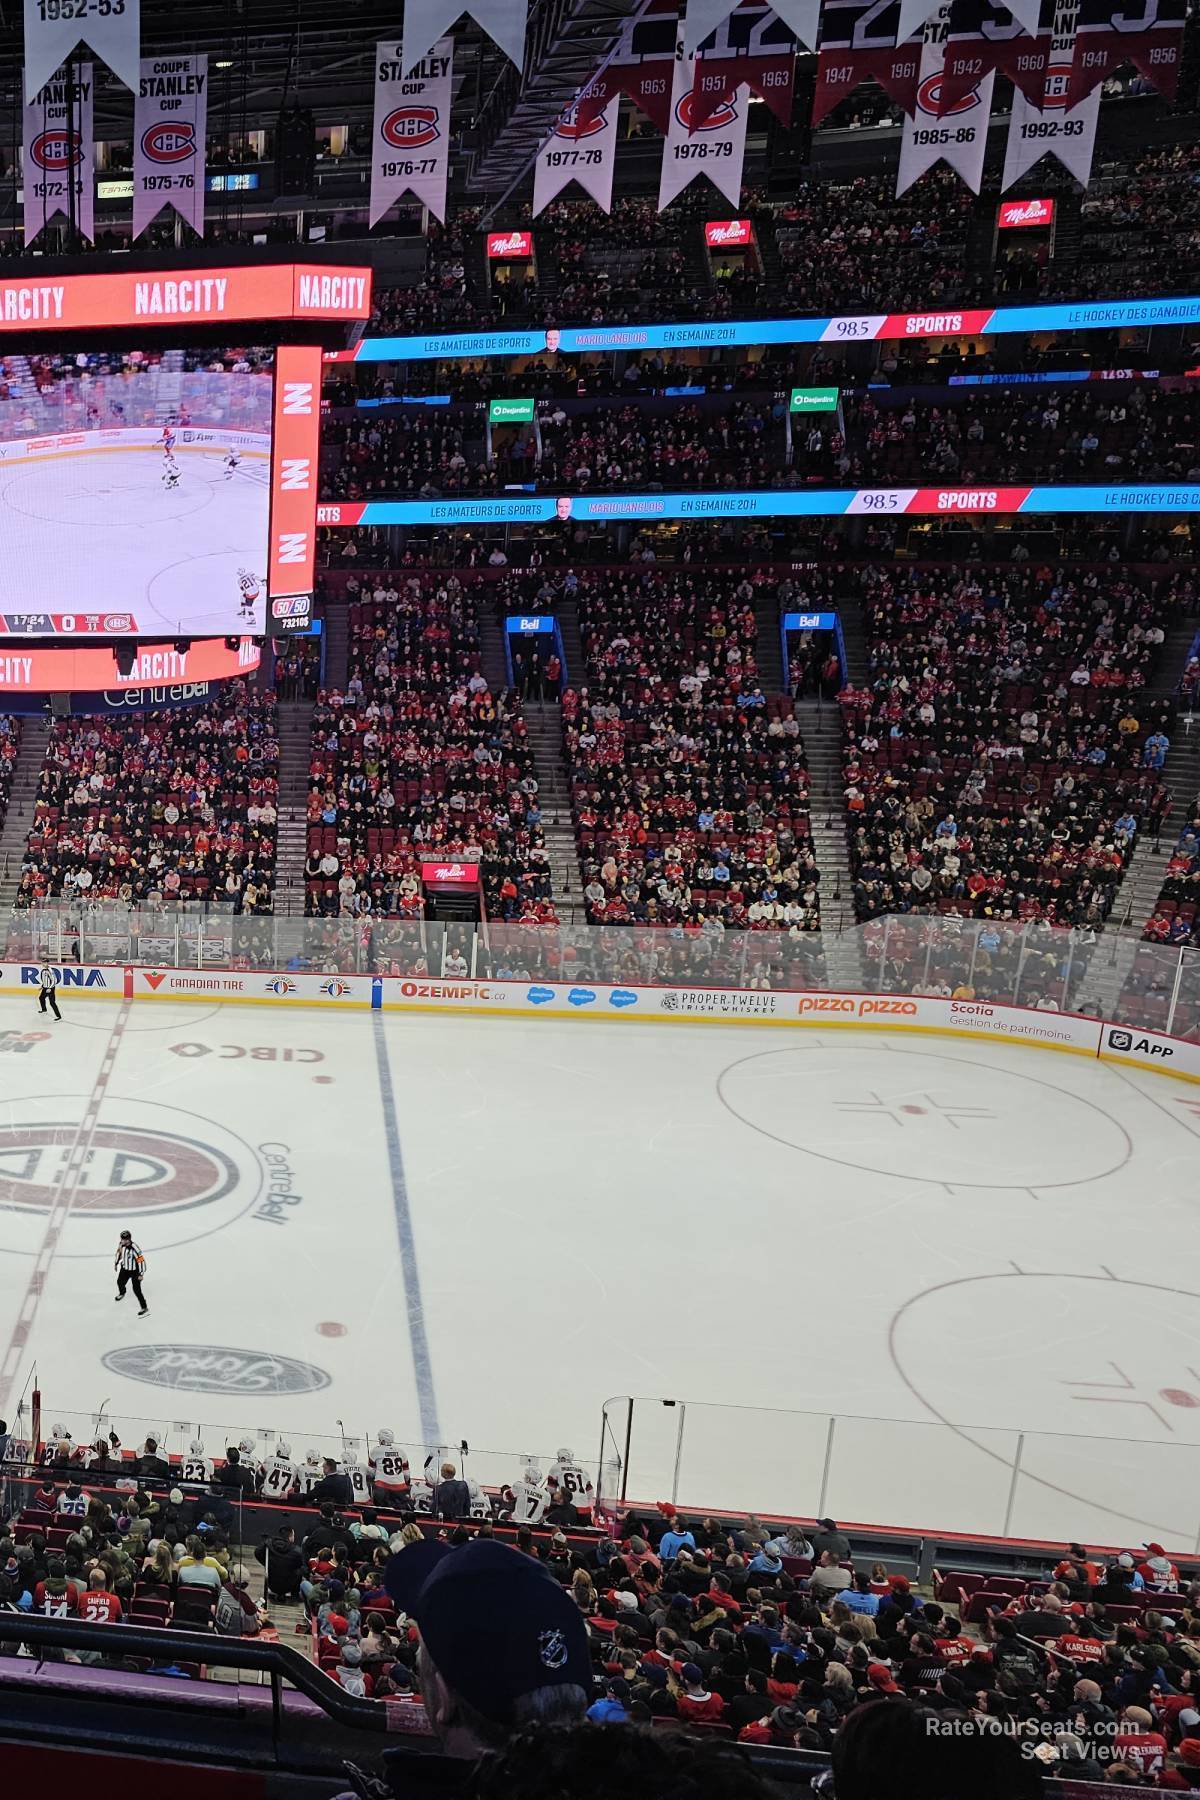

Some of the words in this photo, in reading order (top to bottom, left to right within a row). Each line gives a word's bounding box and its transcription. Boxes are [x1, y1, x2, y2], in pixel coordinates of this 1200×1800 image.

[1016, 54, 1045, 72] 1960
[1081, 50, 1108, 68] 1941
[1149, 48, 1177, 65] 1956
[153, 61, 190, 74] COUPE
[825, 66, 853, 84] 1947
[890, 62, 916, 79] 1961
[952, 58, 983, 76] 1942
[140, 75, 205, 98] STANLEY
[640, 79, 667, 95] 1963
[701, 75, 727, 93] 1951
[762, 71, 790, 88] 1963
[402, 83, 426, 95] CUP
[160, 99, 182, 111] CUP
[912, 128, 976, 145] 1985-86
[1019, 120, 1085, 139] 1992-93
[546, 150, 603, 167] 1977-78
[674, 142, 734, 160] 1978-79
[381, 159, 437, 177] 1976-77
[142, 175, 195, 190] 1975-76
[135, 278, 227, 315] NARCITY
[299, 274, 366, 309] NARCITY
[1083, 309, 1125, 322] HOCKEY
[1127, 308, 1147, 320] DES
[836, 321, 869, 337] 98.5
[906, 314, 962, 334] SPORTS
[424, 341, 438, 352] LES
[440, 339, 482, 351] AMATEURS
[498, 336, 531, 349] SPORTS
[663, 330, 674, 342] EN
[676, 329, 716, 341] SEMAINE
[681, 501, 693, 512] EN
[694, 500, 735, 511] SEMAINE
[863, 494, 898, 510] 98.5
[937, 492, 997, 510] SPORTS
[1105, 493, 1117, 505] LE
[1121, 493, 1164, 505] HOCKEY
[1167, 492, 1189, 504] DES
[431, 507, 445, 518] LES
[447, 505, 491, 518] AMATEURS
[493, 506, 505, 516] DE
[508, 504, 542, 516] SPORTS
[276, 599, 308, 615] 50/50
[13, 615, 45, 625] 17:24
[62, 615, 76, 632] 0
[520, 619, 540, 630] Bell
[799, 615, 820, 627] Bell
[170, 978, 221, 990] CANADIAN
[222, 979, 244, 991] TIRE
[682, 992, 728, 1005] PROPER
[732, 994, 776, 1008] TWELVE
[798, 997, 855, 1016] pizza
[858, 998, 918, 1017] pizza
[681, 1004, 715, 1012] IRISH
[722, 1005, 776, 1014] WHISKEY
[950, 1002, 994, 1017] Scotia
[949, 1014, 992, 1031] Gestion
[993, 1020, 1008, 1032] de
[1009, 1021, 1071, 1042] patrimoine
[219, 1044, 326, 1063] CIBC
[250, 1141, 303, 1226] CentreBell
[149, 1351, 284, 1390] Ford
[185, 1464, 206, 1481] 23
[268, 1472, 294, 1492] 47
[563, 1472, 585, 1495] 61
[526, 1497, 540, 1519] 7
[43, 1602, 69, 1618] 14
[86, 1606, 110, 1623] 22
